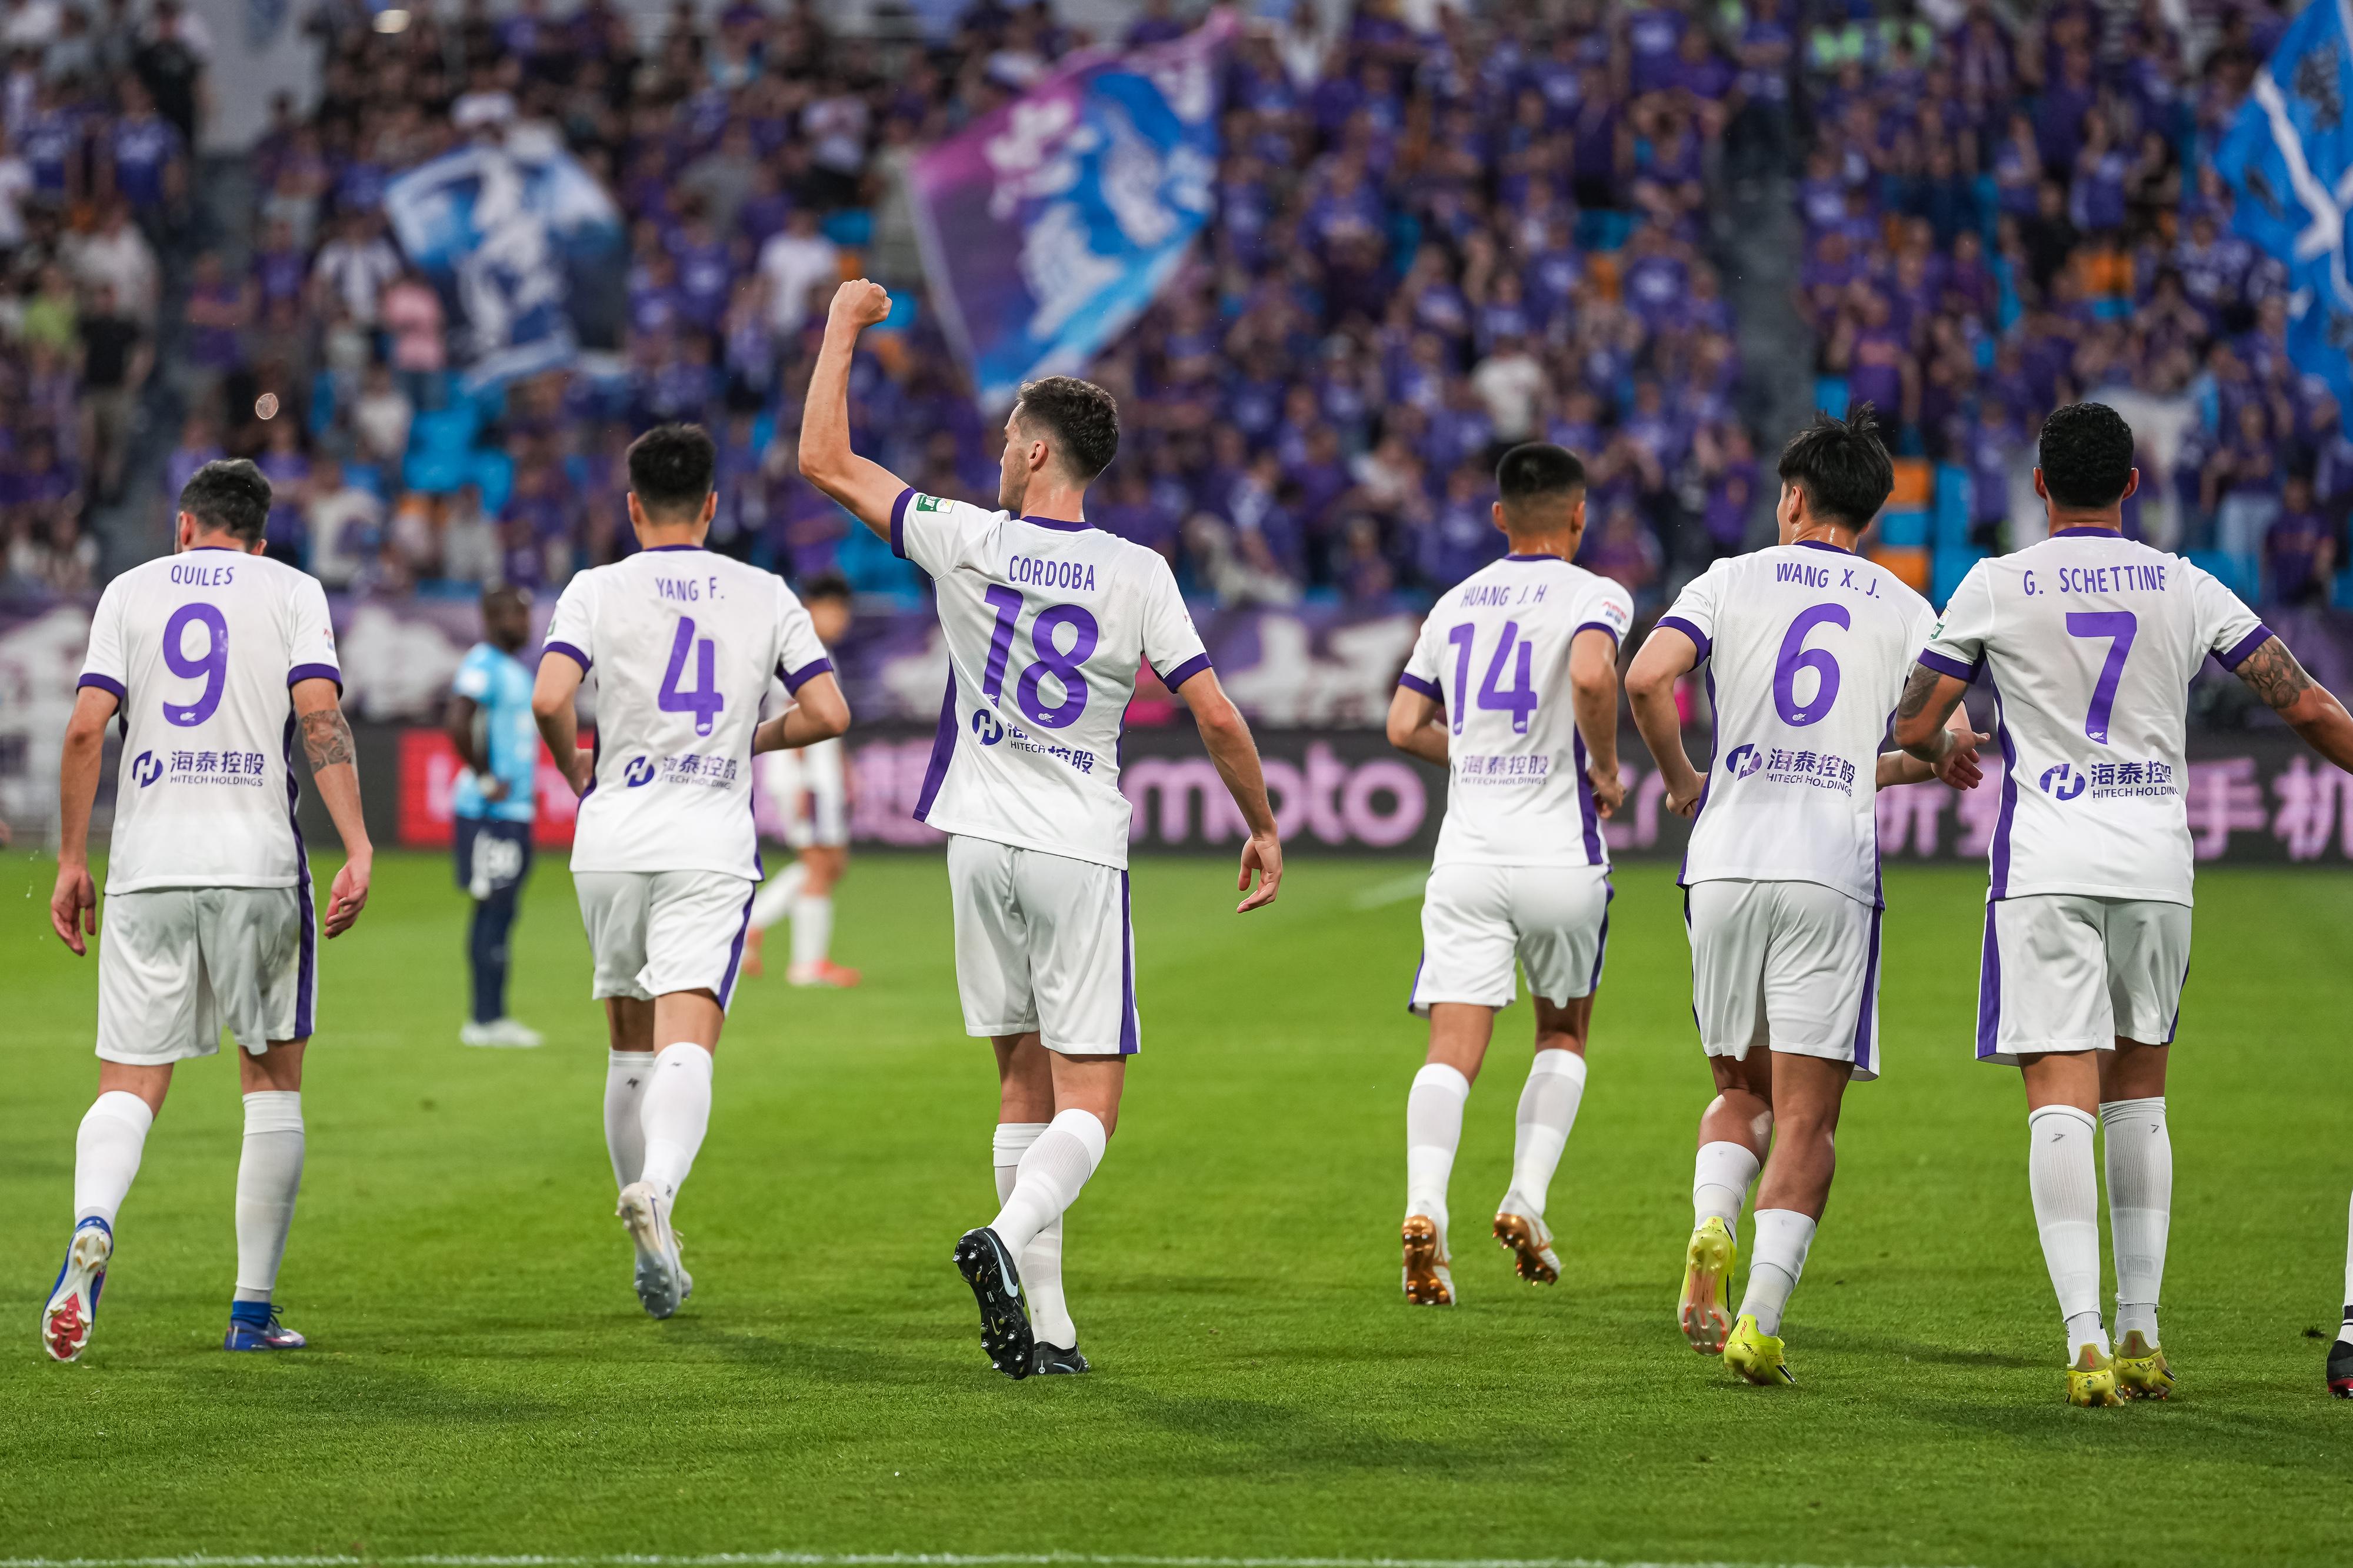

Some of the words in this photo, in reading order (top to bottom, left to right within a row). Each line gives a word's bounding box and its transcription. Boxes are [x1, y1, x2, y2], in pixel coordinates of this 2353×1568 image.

[171, 564, 234, 586] QUILES
[655, 578, 699, 601] YANG
[709, 576, 724, 599] F.
[1009, 555, 1095, 591] CORDOBA
[1777, 562, 1829, 588] WANG
[1839, 568, 1859, 590] X.
[1865, 578, 1880, 599] J.
[2024, 571, 2044, 596] G.
[2059, 565, 2165, 594] SCHETTINE
[1460, 585, 1511, 608] HUANG
[162, 602, 228, 727] 9
[984, 583, 1099, 728] 18
[1773, 603, 1851, 727] 6
[658, 616, 724, 737] 4
[1449, 620, 1537, 736] 14
[2065, 611, 2137, 745] 7
[170, 750, 265, 775] 海泰控股
[1767, 748, 1855, 786] 海泰控股
[170, 775, 208, 784] HITECH
[211, 775, 264, 787] HOLDINGS
[1461, 776, 1497, 786] HITECH
[1765, 772, 1803, 783] HITECH
[1805, 775, 1852, 798] HOLDINGS
[2092, 788, 2133, 799] HITECH
